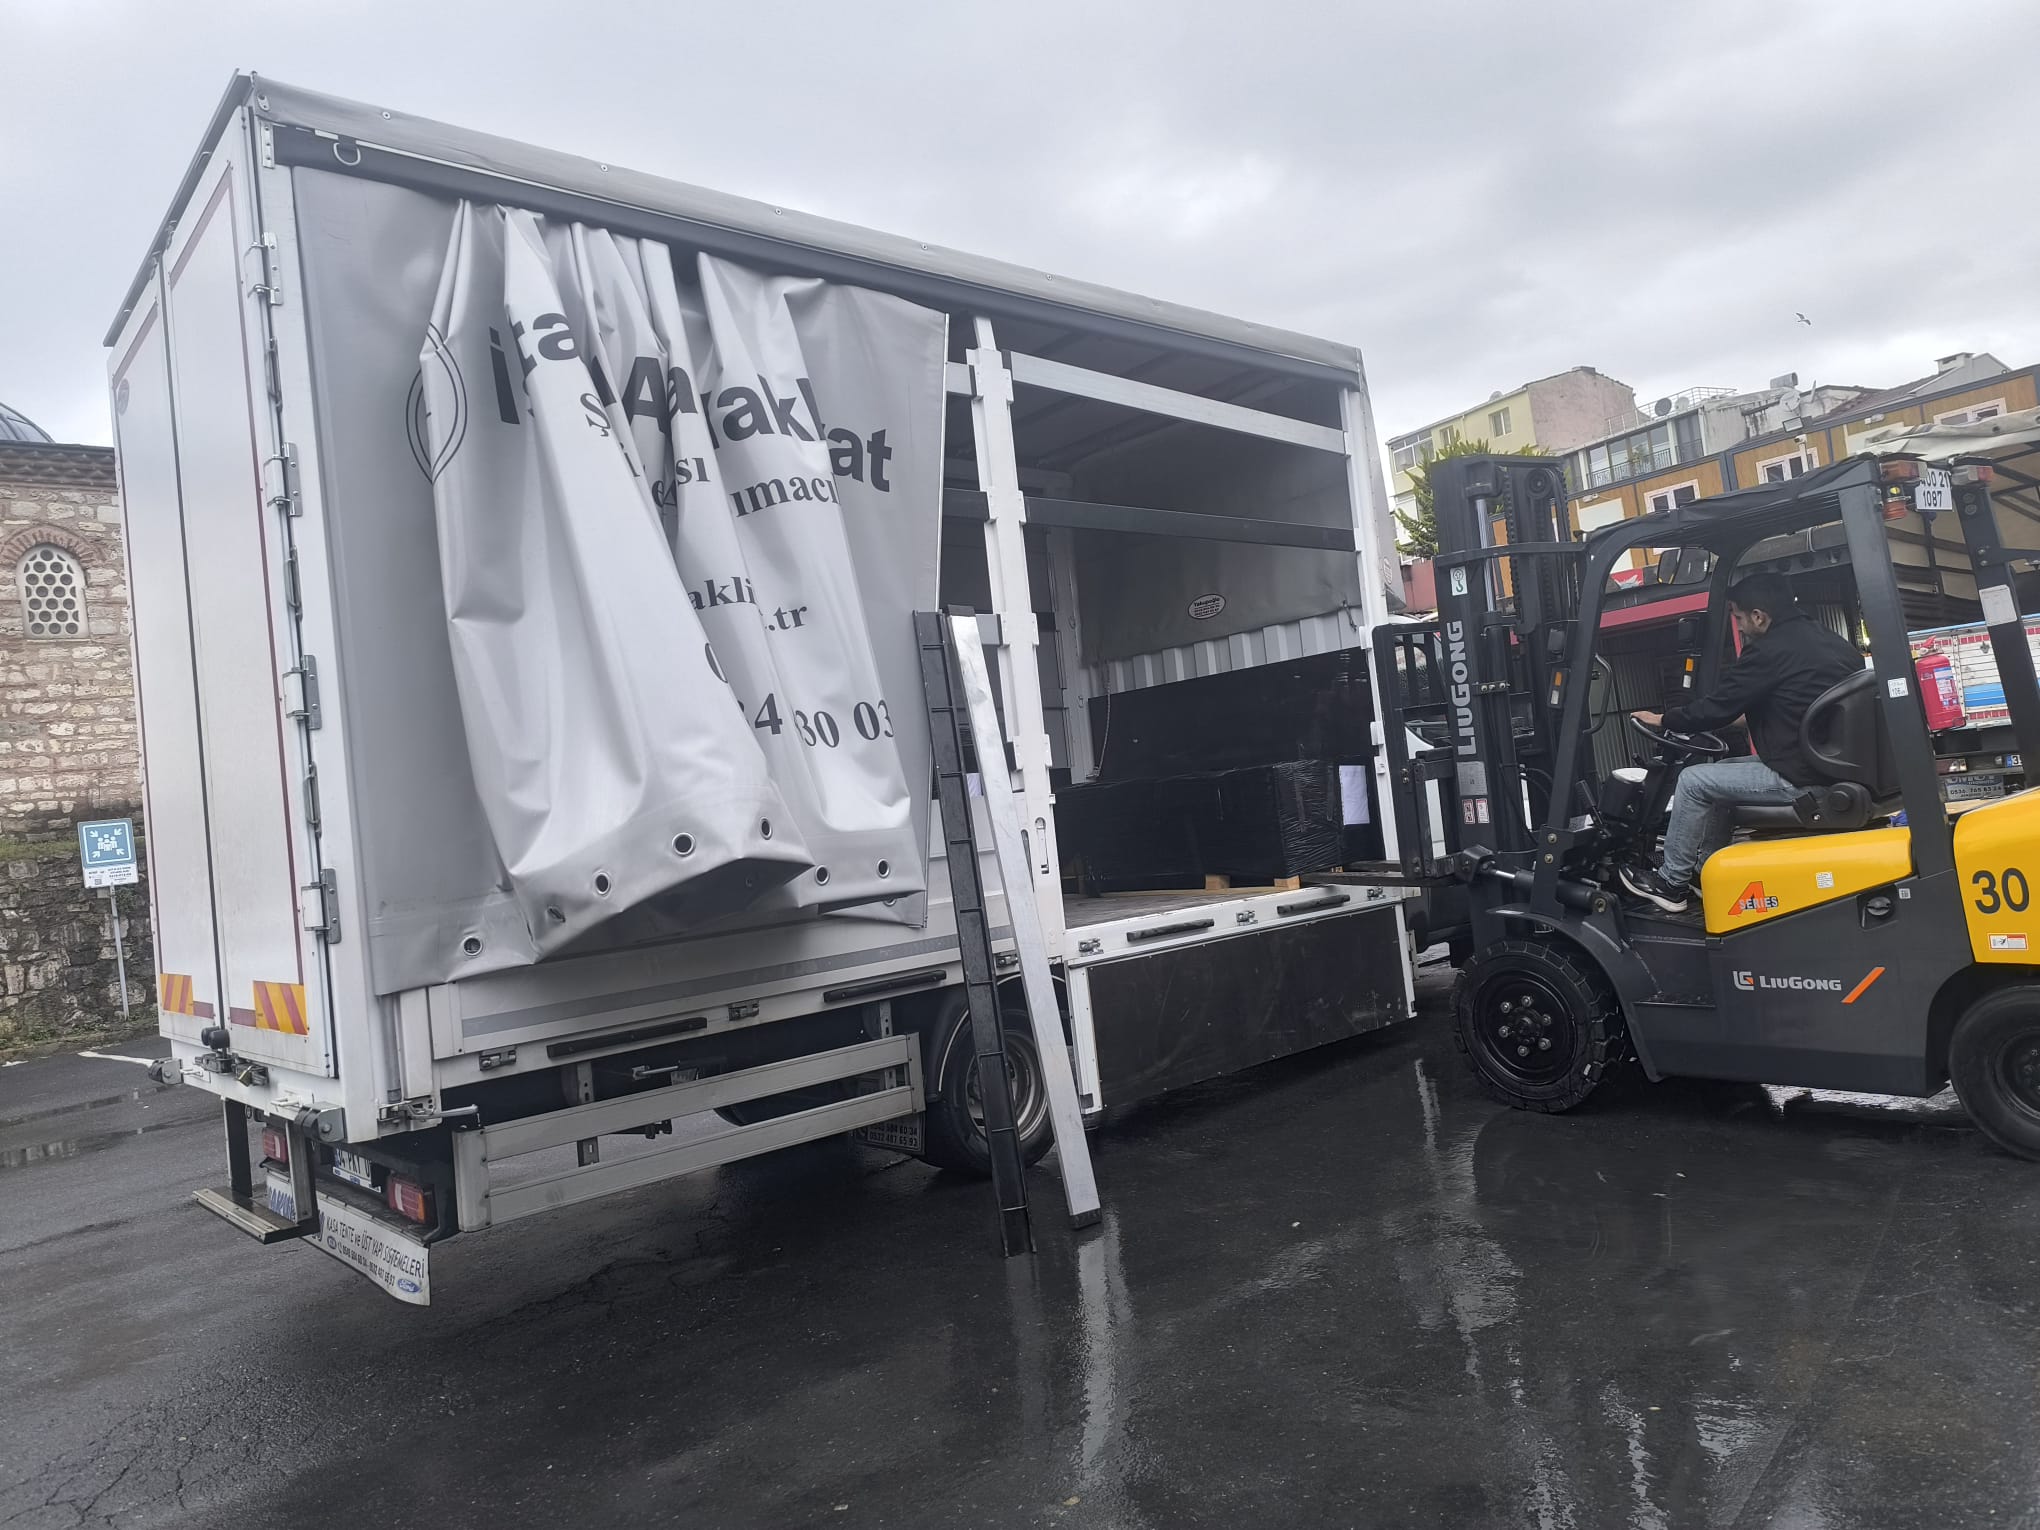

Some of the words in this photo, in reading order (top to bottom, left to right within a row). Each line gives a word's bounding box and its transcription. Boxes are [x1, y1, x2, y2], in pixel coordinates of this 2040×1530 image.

[1922, 489, 1943, 508] 1087
[688, 576, 758, 611] akli
[764, 605, 808, 632] .tr
[1738, 895, 1779, 911] SERIES
[1971, 867, 2030, 915] 30
[326, 1216, 339, 1234] KASA
[340, 1221, 355, 1243] TENTE
